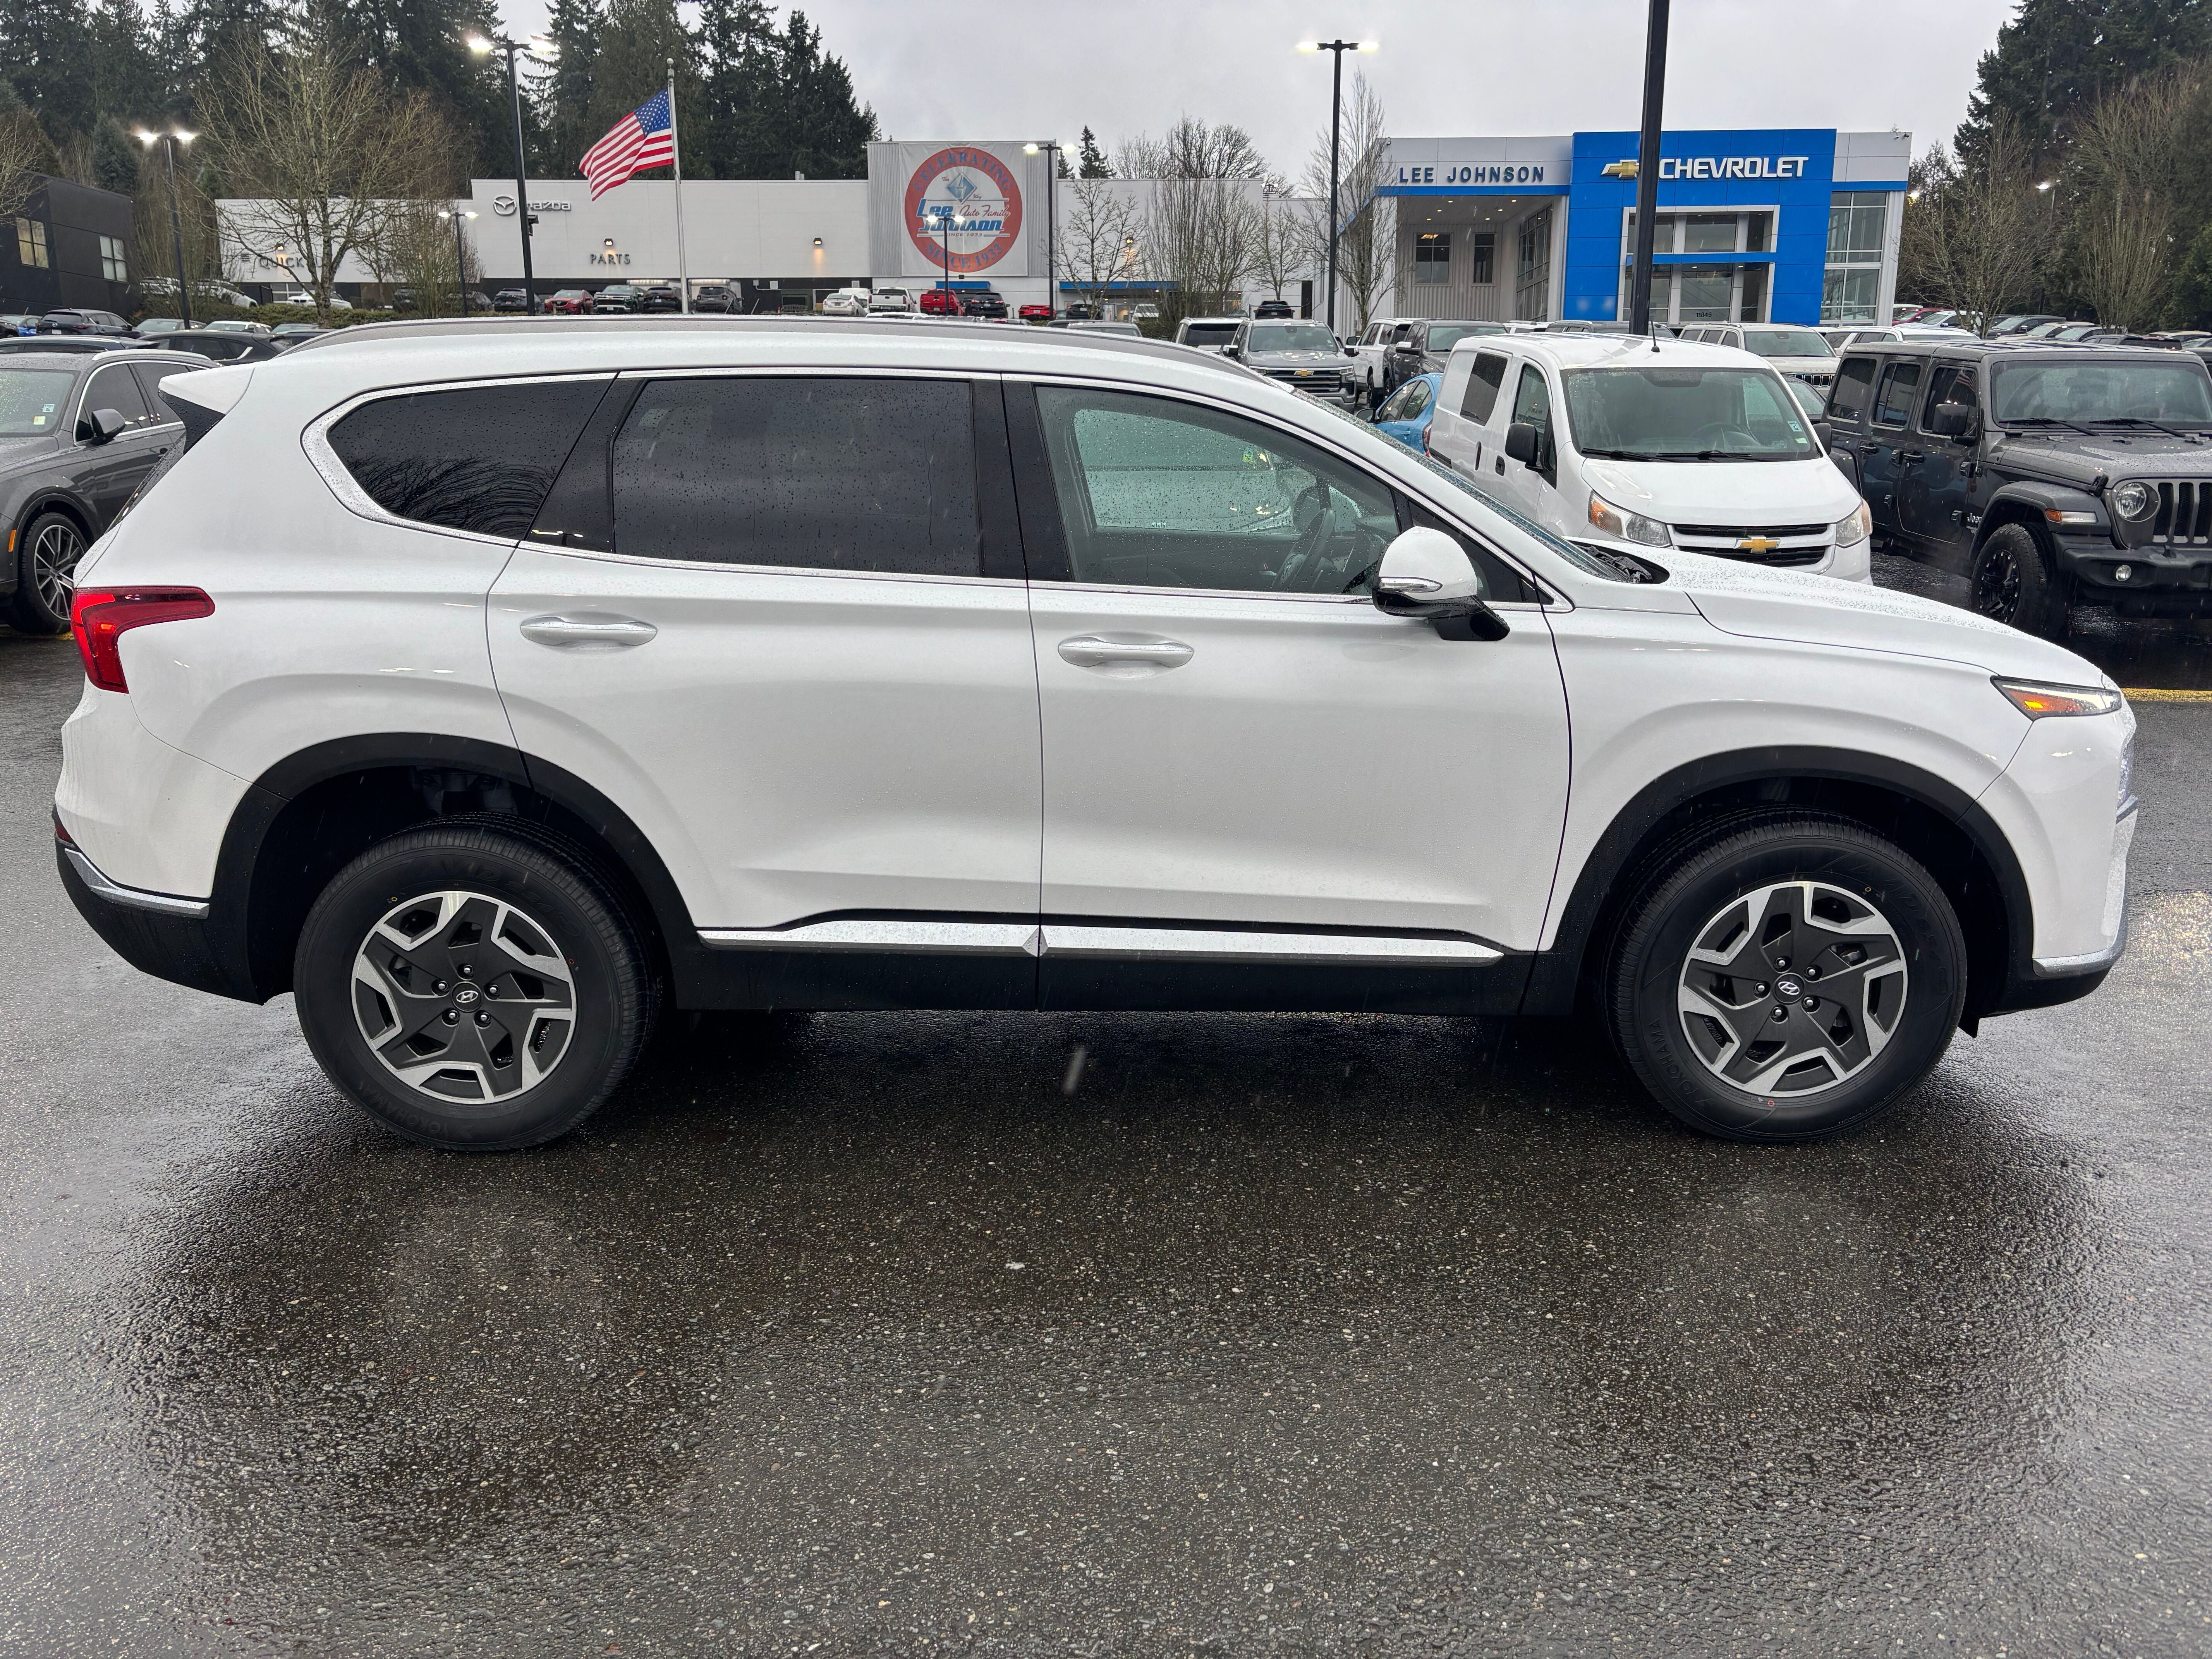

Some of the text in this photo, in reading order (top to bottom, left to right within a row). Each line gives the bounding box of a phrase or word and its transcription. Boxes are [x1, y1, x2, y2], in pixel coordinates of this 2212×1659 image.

[913, 151, 1012, 191] CELEBRATING
[1400, 167, 1544, 183] LEE JOHNSON
[1659, 157, 1809, 179] CHEVROLET
[917, 199, 955, 217] Lee
[959, 204, 1011, 222] Auto Family
[259, 257, 304, 269] QUICK
[590, 254, 630, 264] PARTS
[975, 243, 1003, 266] 1933
